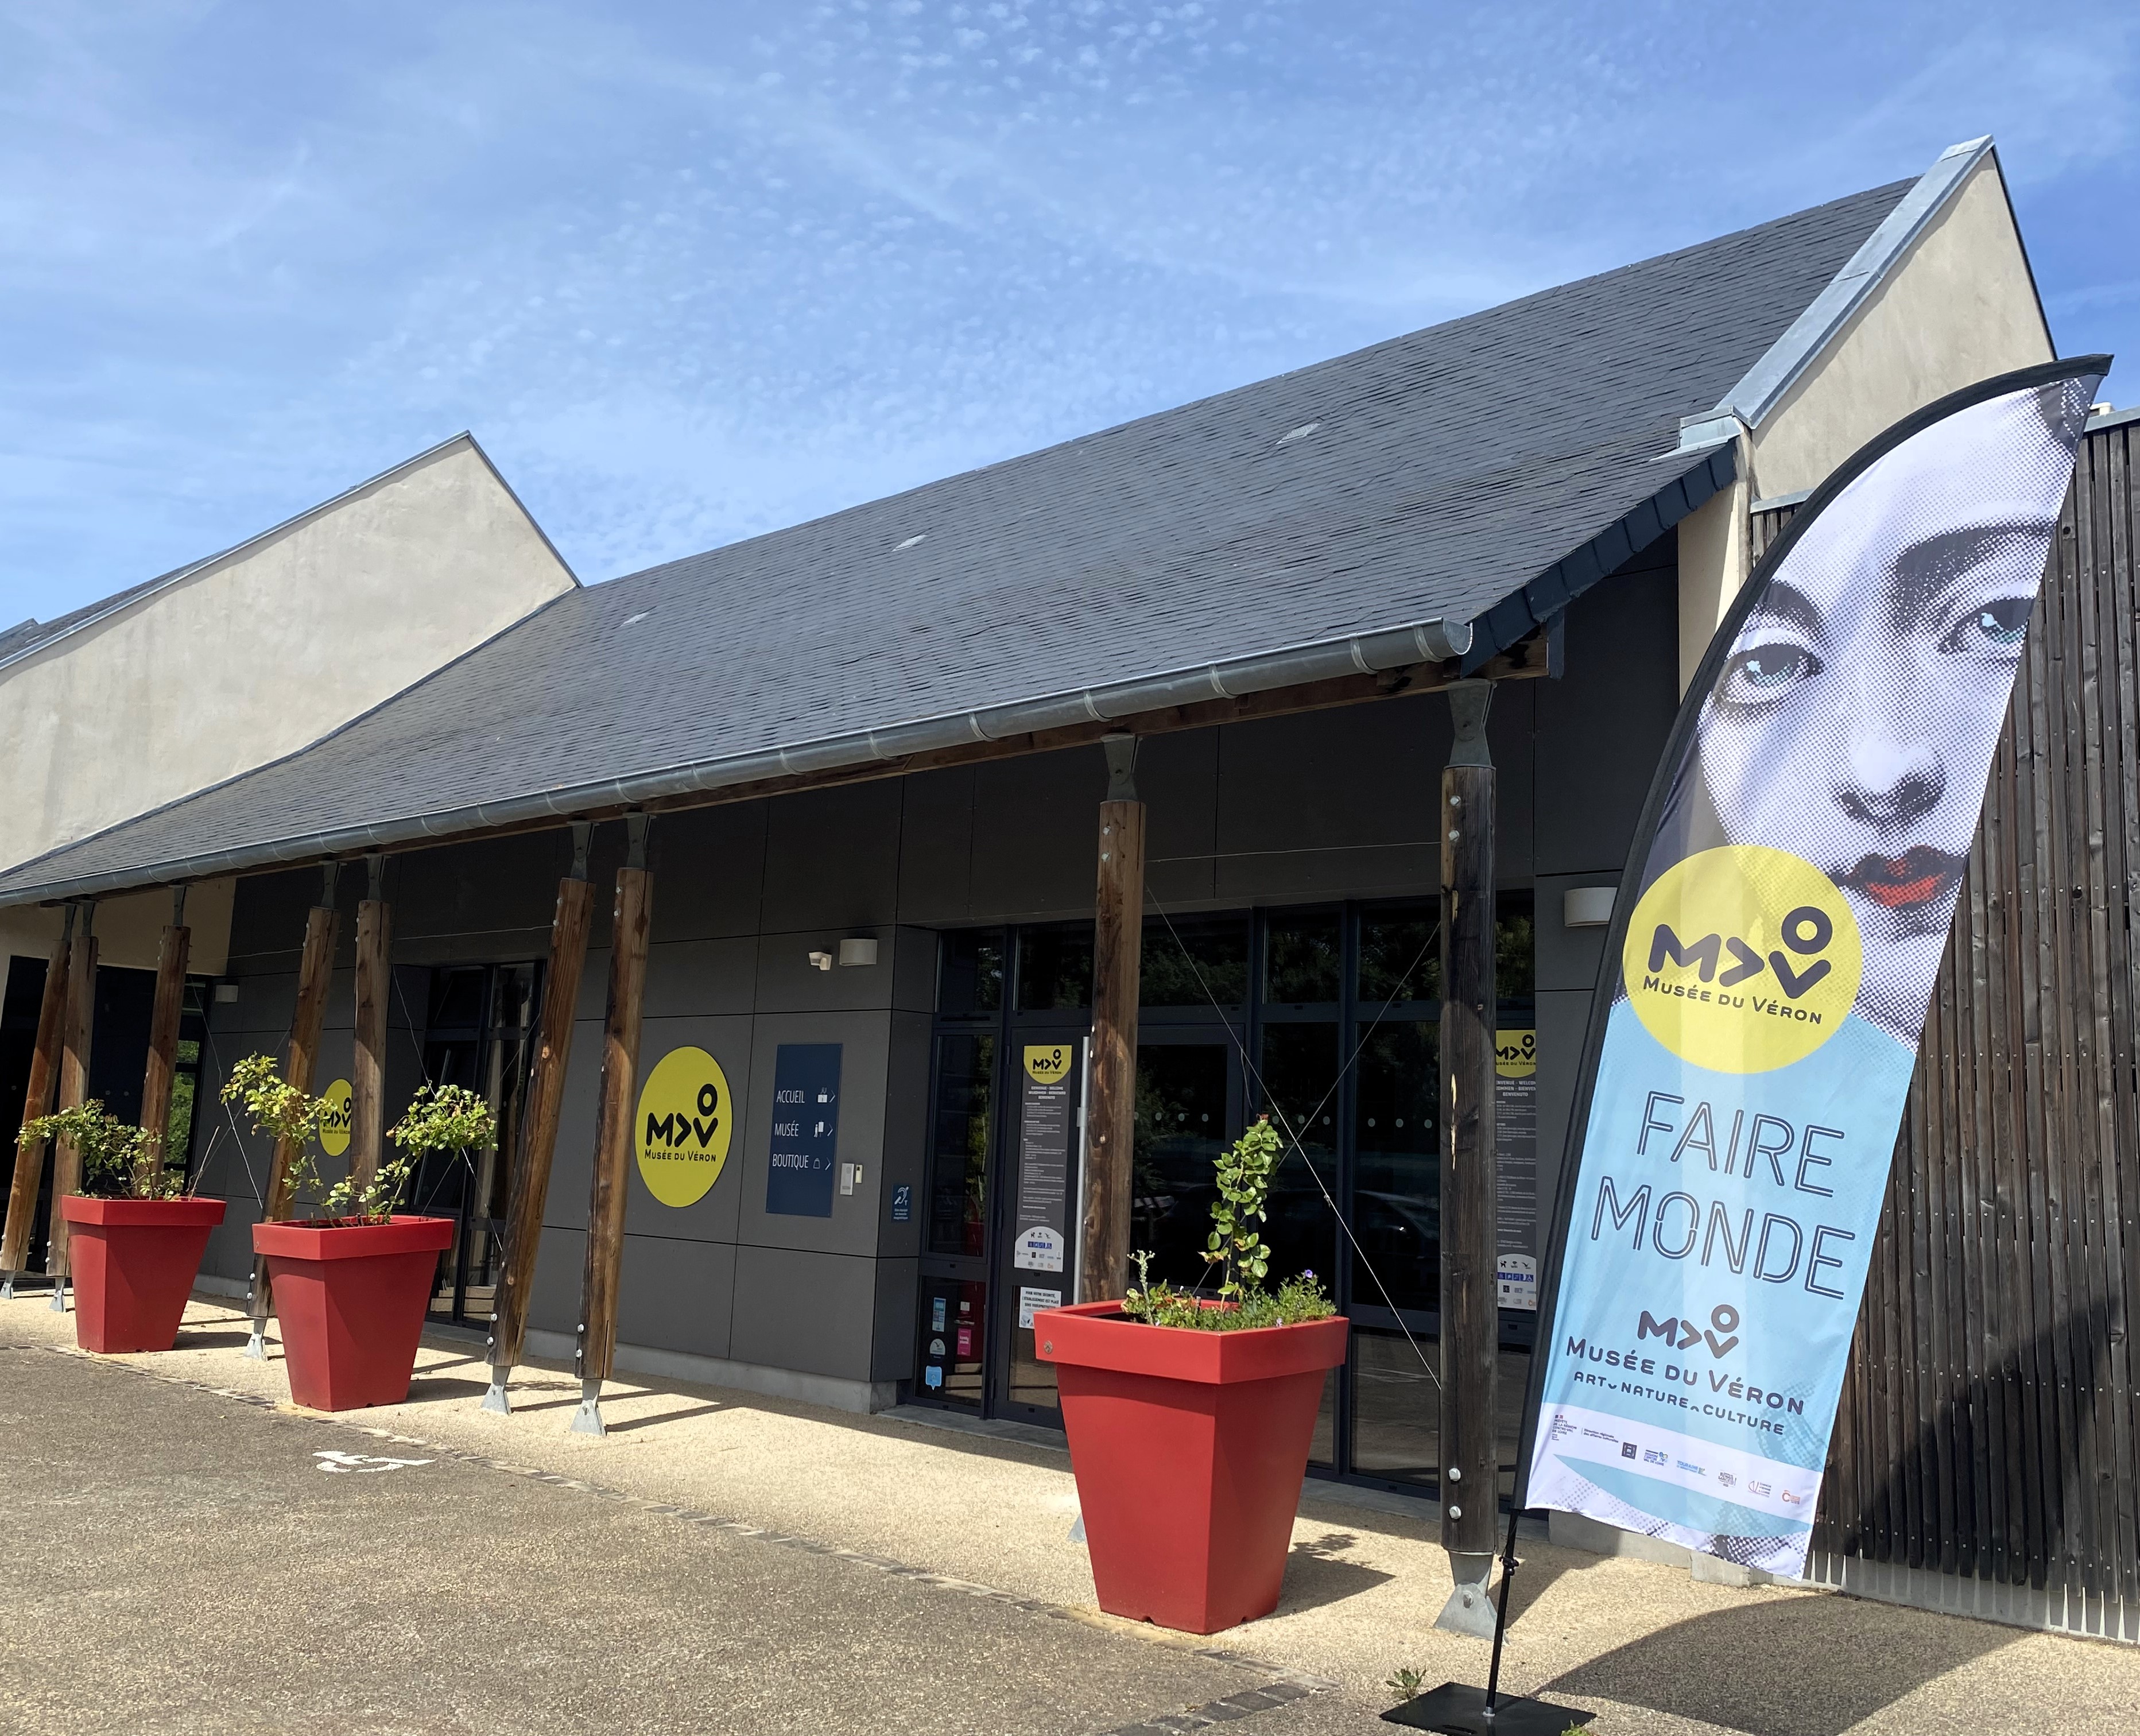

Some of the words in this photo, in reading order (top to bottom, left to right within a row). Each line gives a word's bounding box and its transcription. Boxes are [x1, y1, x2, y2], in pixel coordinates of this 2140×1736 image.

[1643, 975, 1712, 1002] MUSÉE
[1718, 994, 1744, 1009] DU
[1752, 995, 1822, 1025] VÉRON
[776, 1090, 805, 1104] ACCUEIL
[774, 1121, 800, 1137] MUSÉE
[1637, 1091, 1845, 1198] FAIRE
[644, 1149, 672, 1160] MUSÉE
[674, 1152, 685, 1161] DU
[687, 1150, 716, 1162] VÉRON
[772, 1153, 809, 1171] BOUTIQUE
[1591, 1176, 1855, 1300] MONDE
[1566, 1335, 1656, 1375] MUSÉE
[1665, 1364, 1698, 1386] DU
[1708, 1369, 1804, 1416] VÉRON
[1574, 1371, 1607, 1388] ART
[1621, 1383, 1689, 1408] NATURE
[1703, 1404, 1785, 1435] CULTURE
